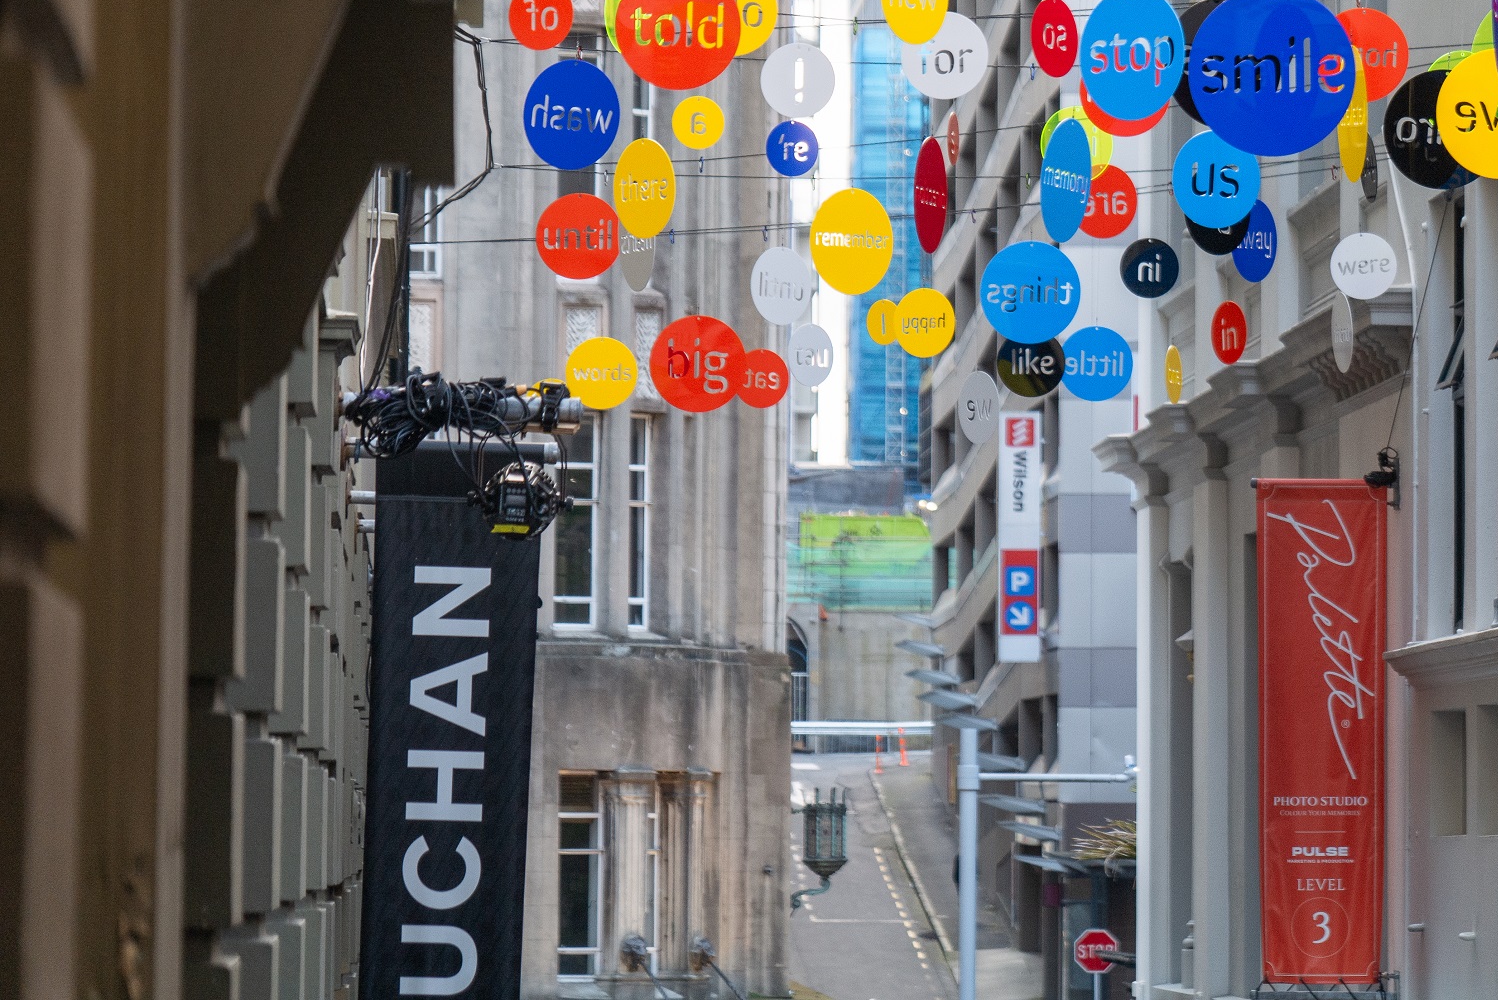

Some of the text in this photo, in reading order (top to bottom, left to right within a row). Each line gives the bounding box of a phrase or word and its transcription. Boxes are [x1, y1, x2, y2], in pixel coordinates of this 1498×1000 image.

[629, 1, 725, 49] told
[917, 39, 973, 75] for
[1090, 32, 1175, 88] stop
[1201, 35, 1346, 94] smile
[778, 133, 809, 162] 're
[619, 173, 669, 203] there
[1044, 165, 1088, 204] memory
[1191, 161, 1240, 197] us
[543, 219, 613, 251] until
[814, 230, 890, 249] remember
[1337, 256, 1390, 277] were
[1221, 318, 1237, 352] in
[573, 363, 632, 381] words
[667, 338, 728, 395] big
[1011, 348, 1055, 376] like
[1013, 450, 1027, 513] Wilson
[1011, 571, 1029, 593] P
[398, 565, 493, 998] UCHAN
[1273, 796, 1368, 807] PHOTO STUDIO
[1292, 846, 1349, 857] PULSE
[1297, 878, 1346, 891] LEVEL
[1312, 911, 1331, 944] 3
